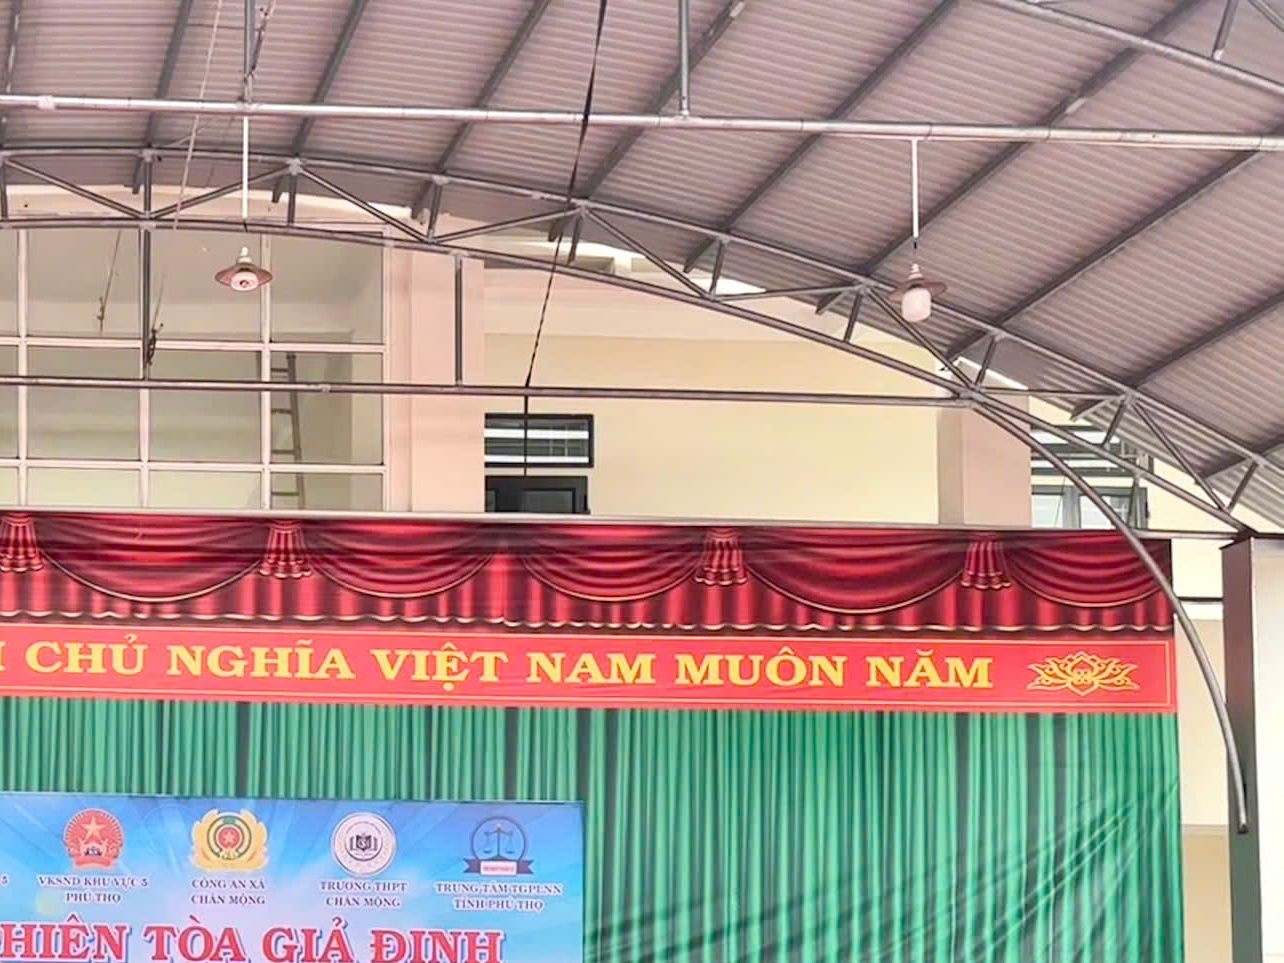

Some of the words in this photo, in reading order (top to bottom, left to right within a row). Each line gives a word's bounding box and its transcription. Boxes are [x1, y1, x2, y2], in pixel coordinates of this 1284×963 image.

[25, 633, 148, 676] CHỦ
[166, 639, 355, 680] NGHĨA
[370, 641, 509, 692] VIỆT
[526, 651, 657, 686] NAM
[674, 645, 848, 688] MUÔN
[866, 648, 994, 689] NĂM
[143, 915, 248, 963] TÒA
